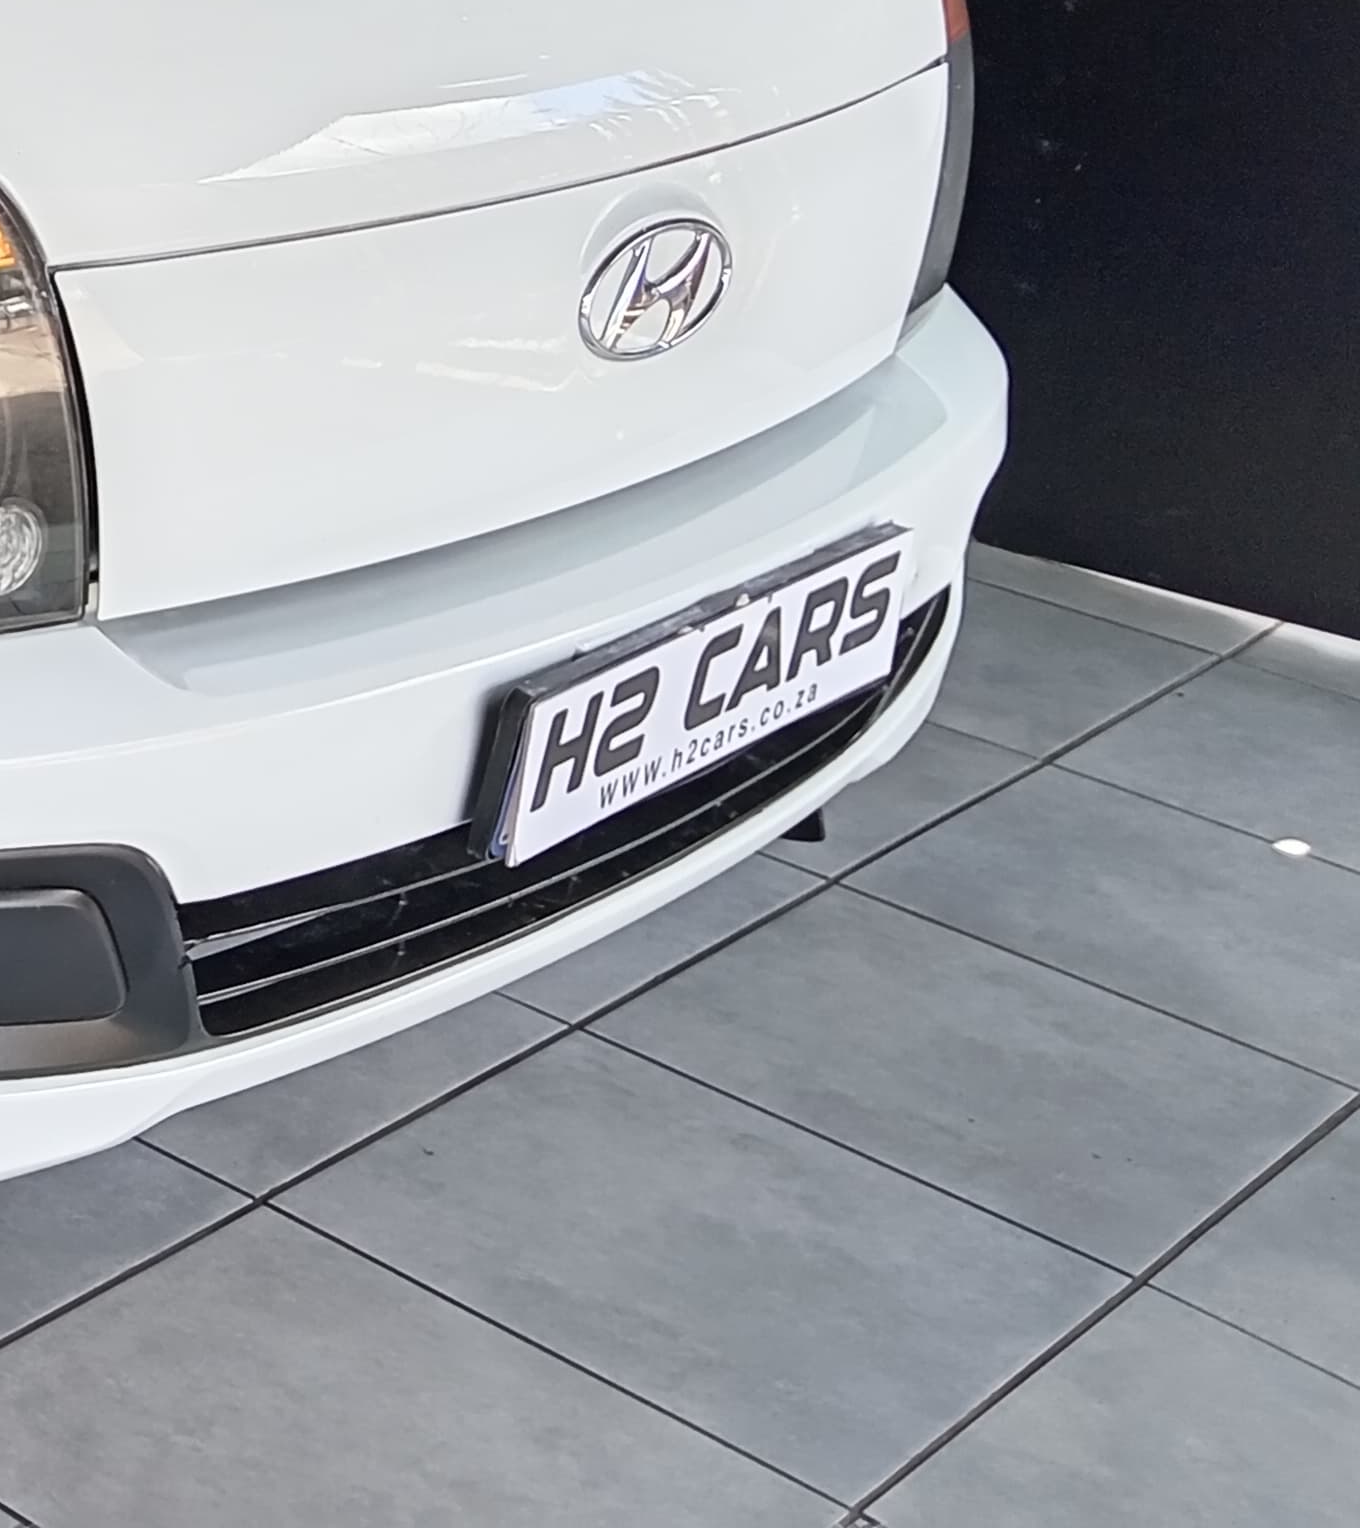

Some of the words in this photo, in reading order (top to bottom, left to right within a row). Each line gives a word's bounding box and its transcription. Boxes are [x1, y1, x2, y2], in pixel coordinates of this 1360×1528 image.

[529, 665, 661, 814] H2
[683, 550, 902, 732] CARS
[598, 682, 819, 810] www.h2cars.co.za
